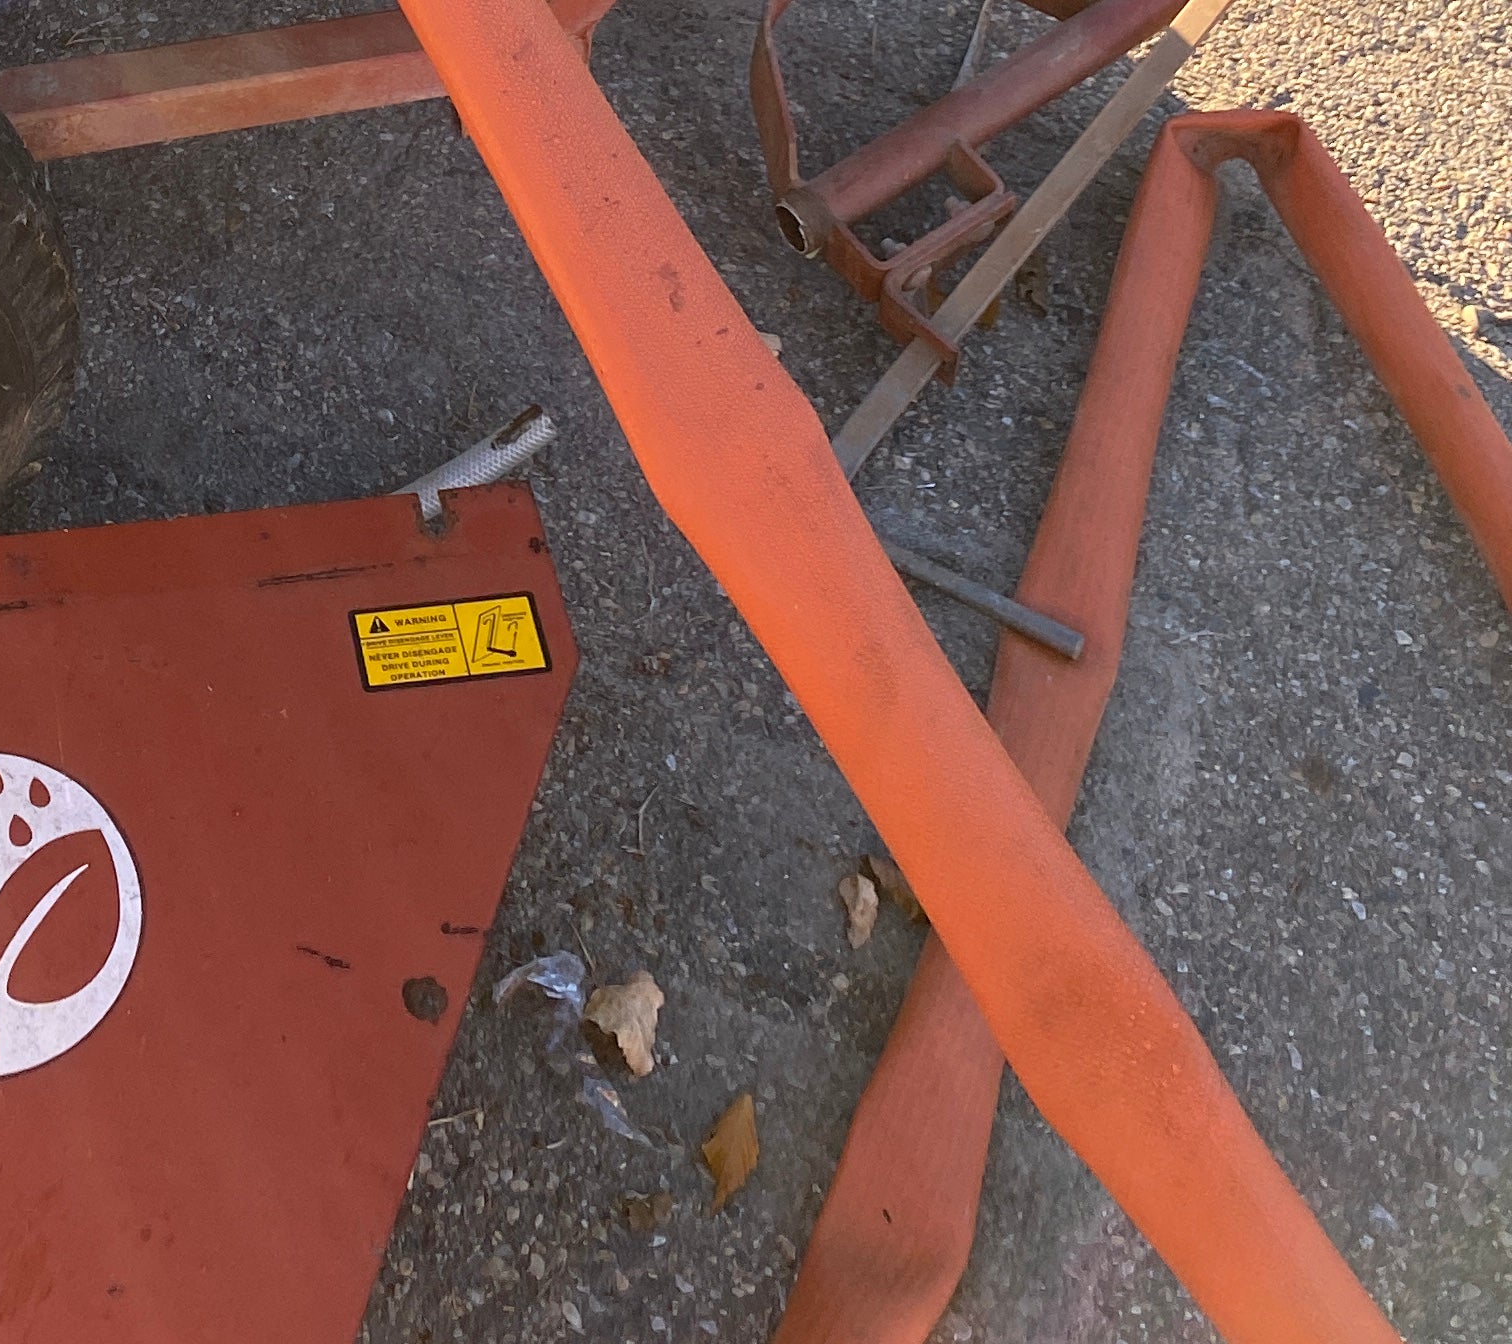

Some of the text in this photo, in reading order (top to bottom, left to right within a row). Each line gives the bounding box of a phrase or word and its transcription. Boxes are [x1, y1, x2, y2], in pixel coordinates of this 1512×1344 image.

[394, 614, 447, 627] WARNING
[369, 645, 457, 662] NEVER DISENGAGE
[381, 657, 450, 672] DRIVE DURING
[390, 669, 446, 682] OPERATION
